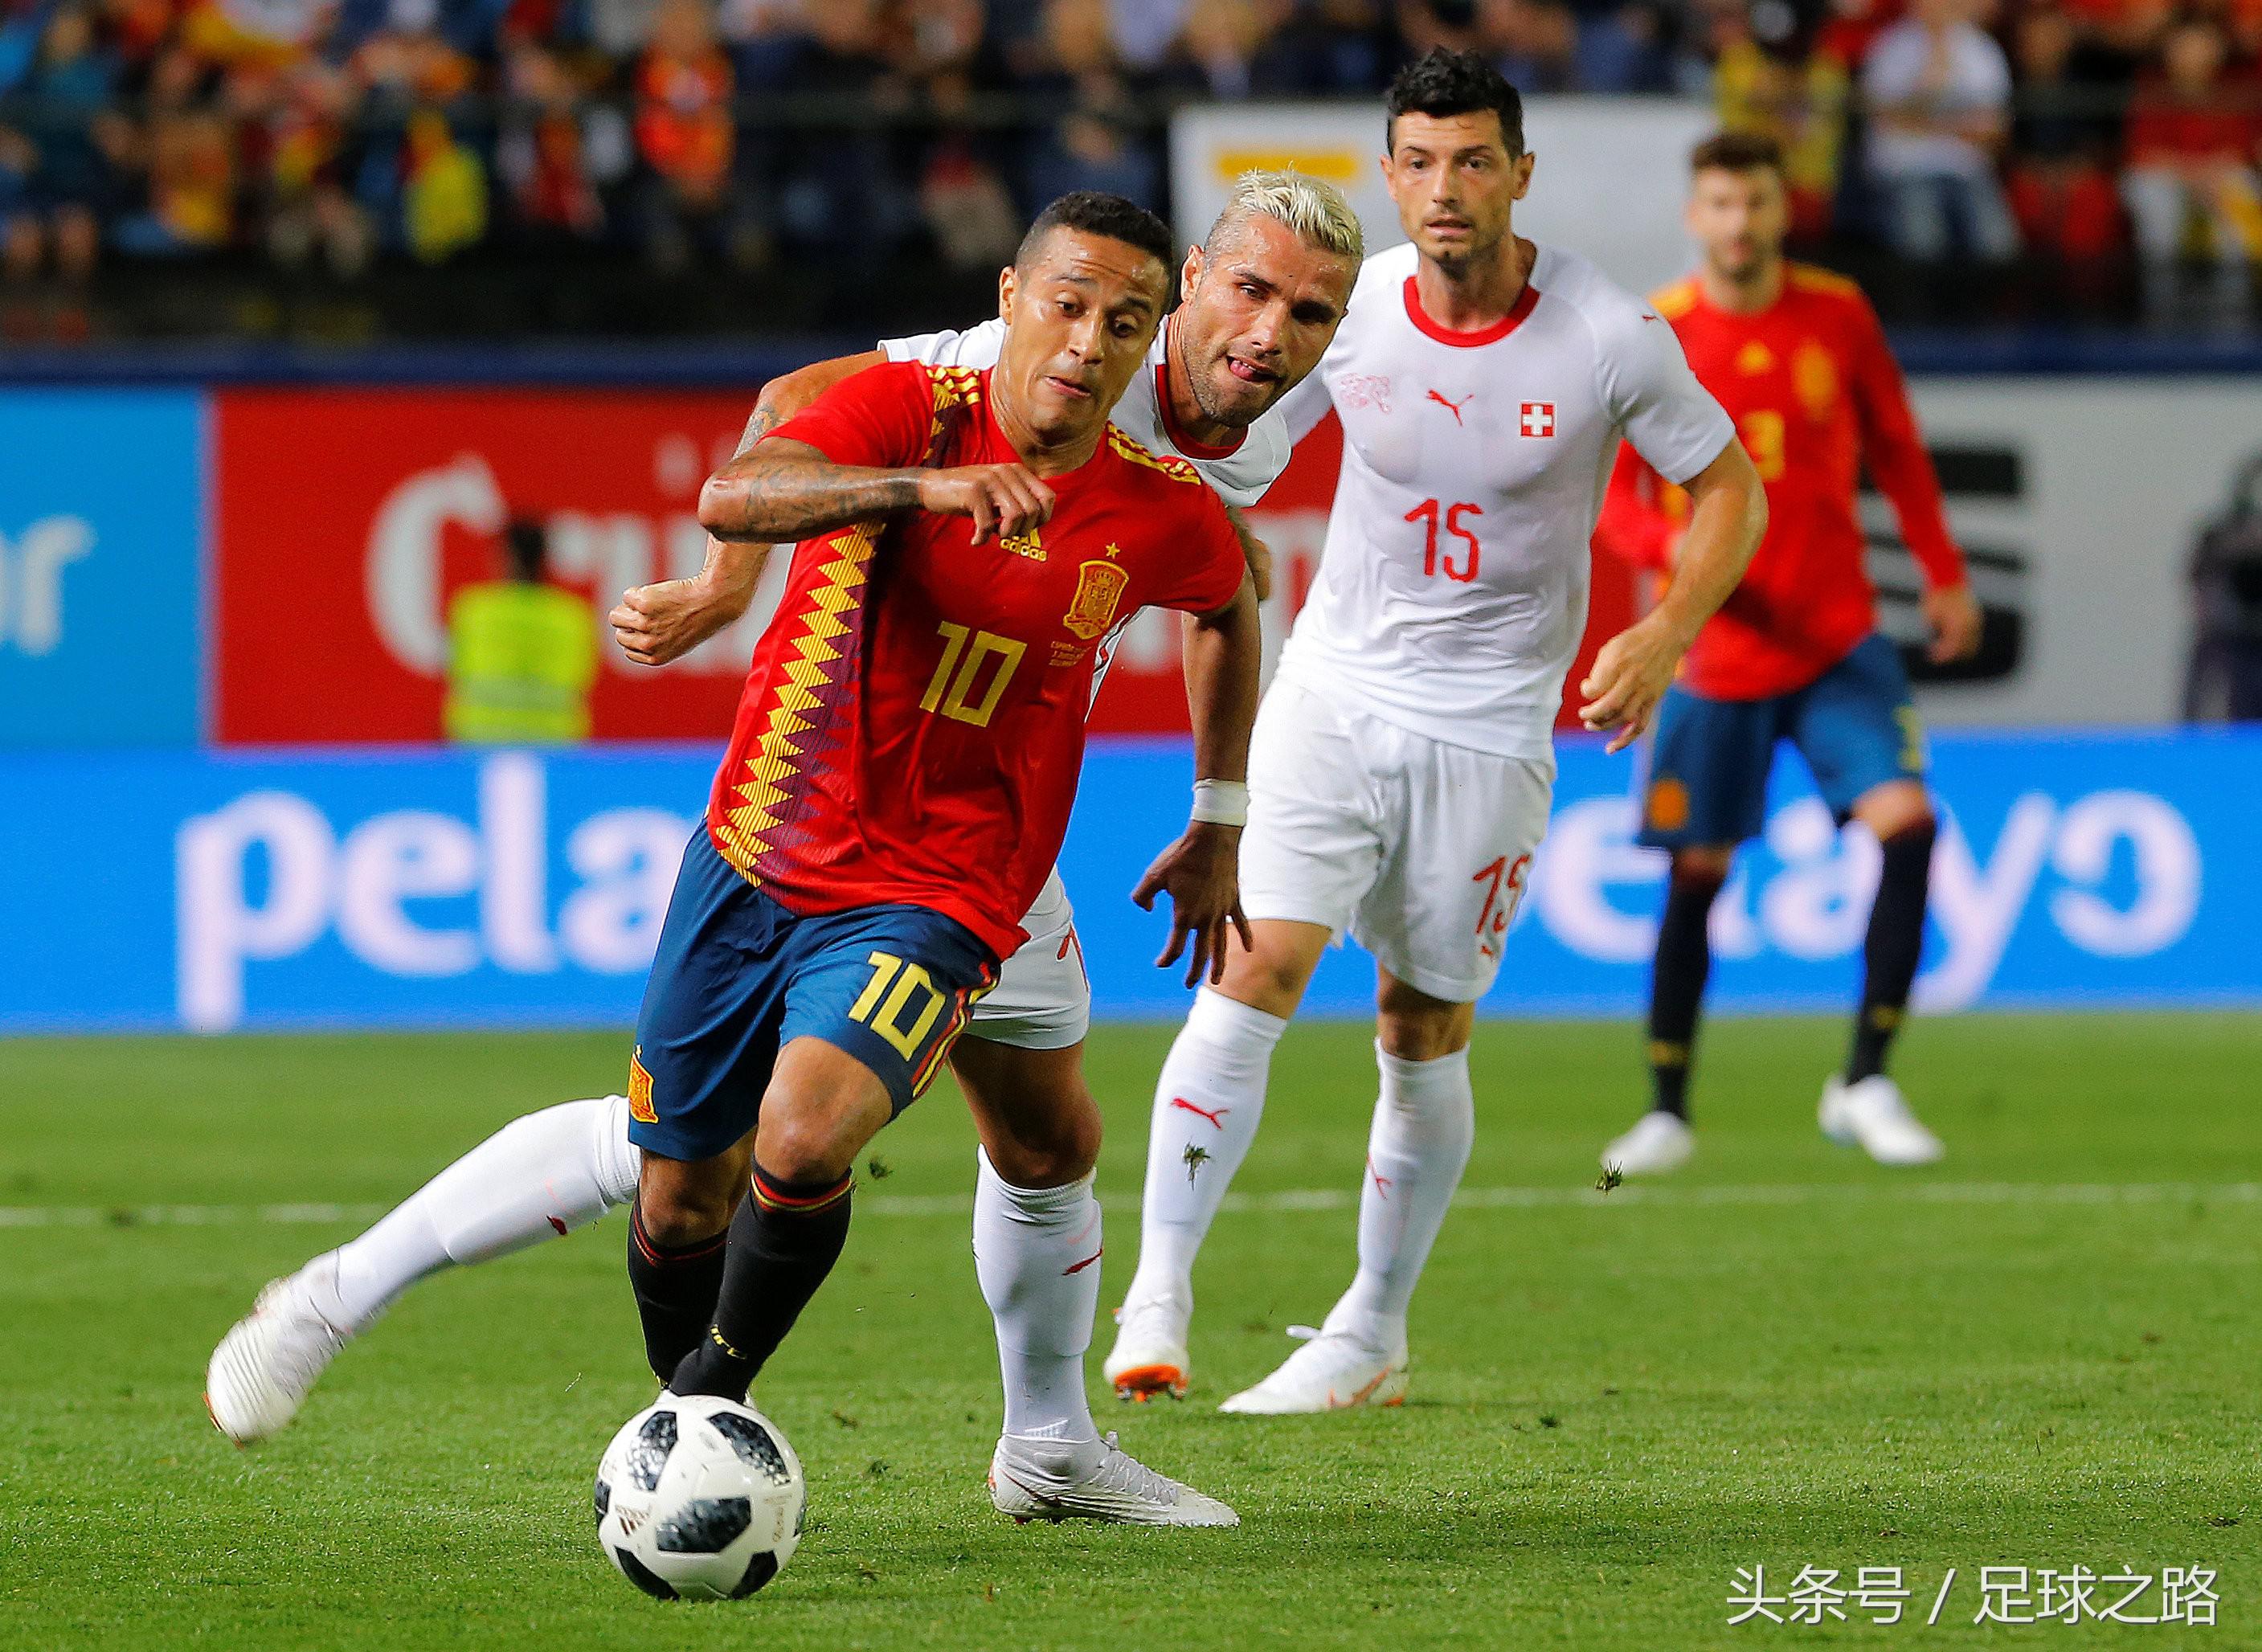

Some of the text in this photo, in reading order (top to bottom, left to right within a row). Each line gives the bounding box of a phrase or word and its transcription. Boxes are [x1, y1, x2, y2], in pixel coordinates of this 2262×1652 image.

[1405, 498, 1484, 583] 15
[919, 620, 1028, 727] 10
[175, 751, 694, 1032] pela
[1473, 853, 1532, 934] 15
[848, 951, 946, 1061] 10
